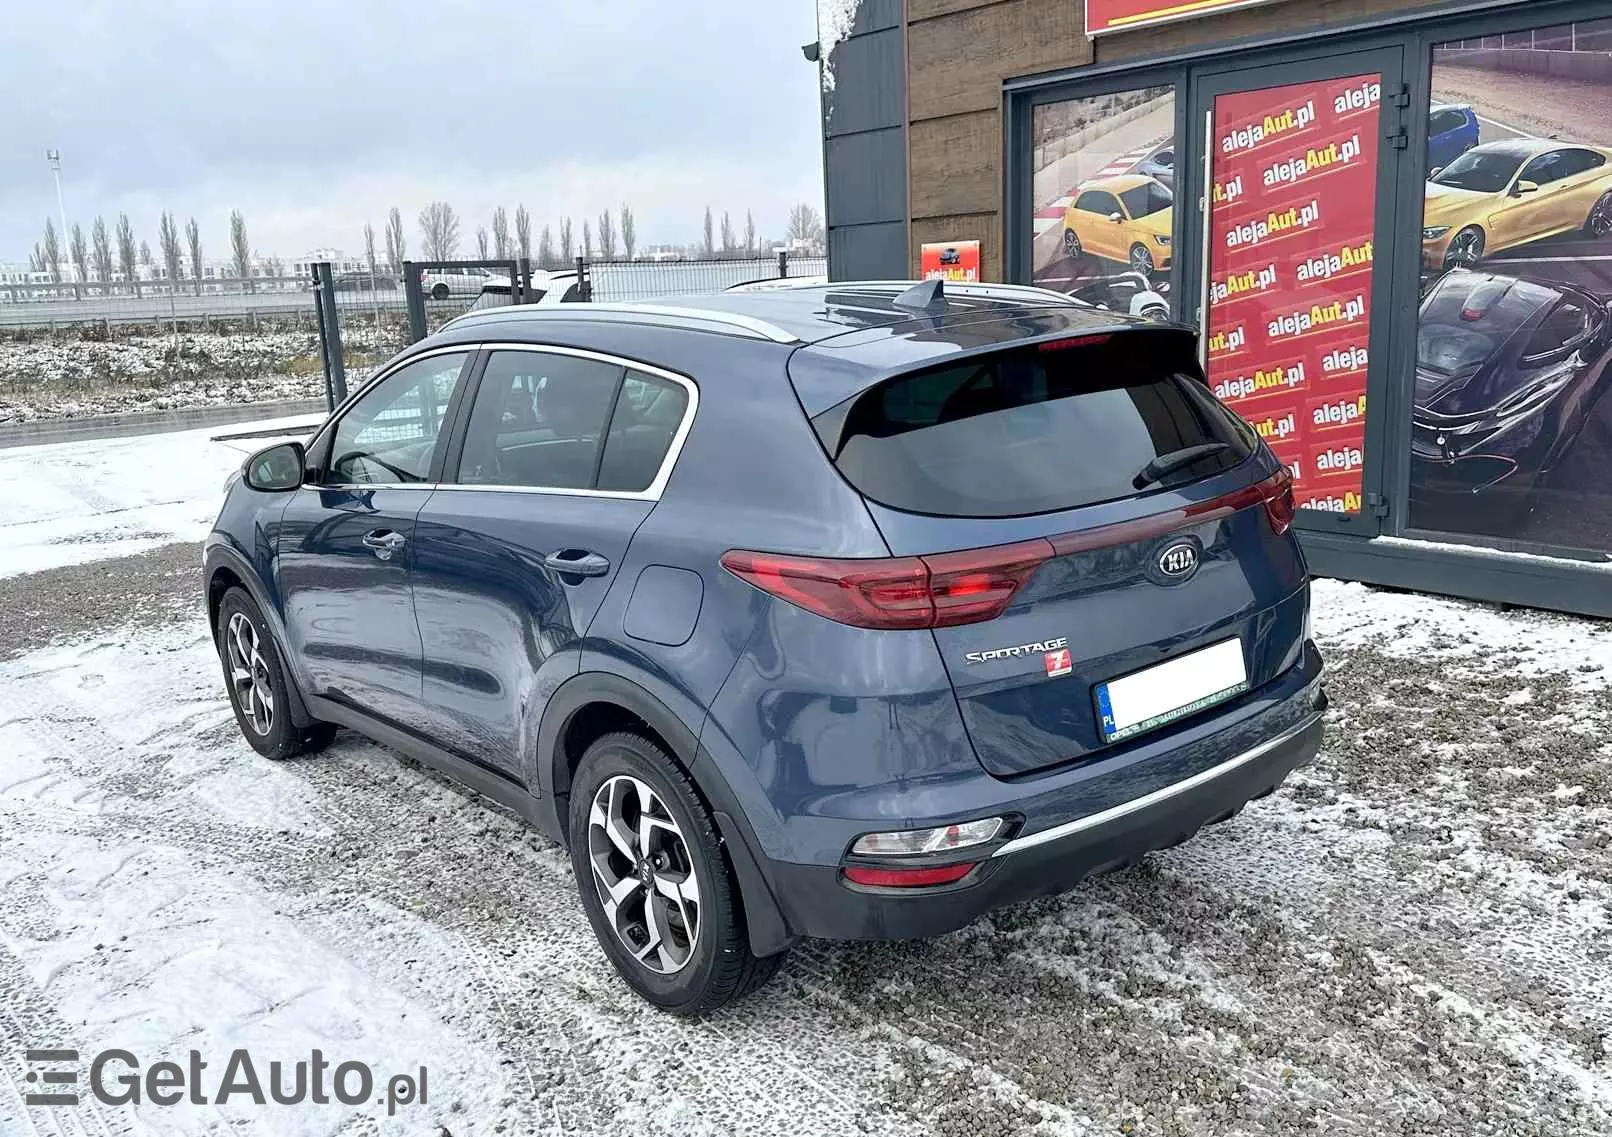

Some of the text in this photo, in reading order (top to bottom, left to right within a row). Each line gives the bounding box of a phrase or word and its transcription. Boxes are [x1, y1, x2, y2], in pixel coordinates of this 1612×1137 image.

[1222, 100, 1315, 152] alejaAut.pl
[1263, 134, 1361, 186] alejaAut.pl
[1226, 200, 1319, 248] alejaAut.pl
[1267, 295, 1365, 337] alejaAut.pl
[1214, 362, 1305, 399] alejaAut.pl
[1167, 549, 1194, 571] KIA
[966, 637, 1068, 665] SPORTAGE
[1103, 715, 1115, 727] PL
